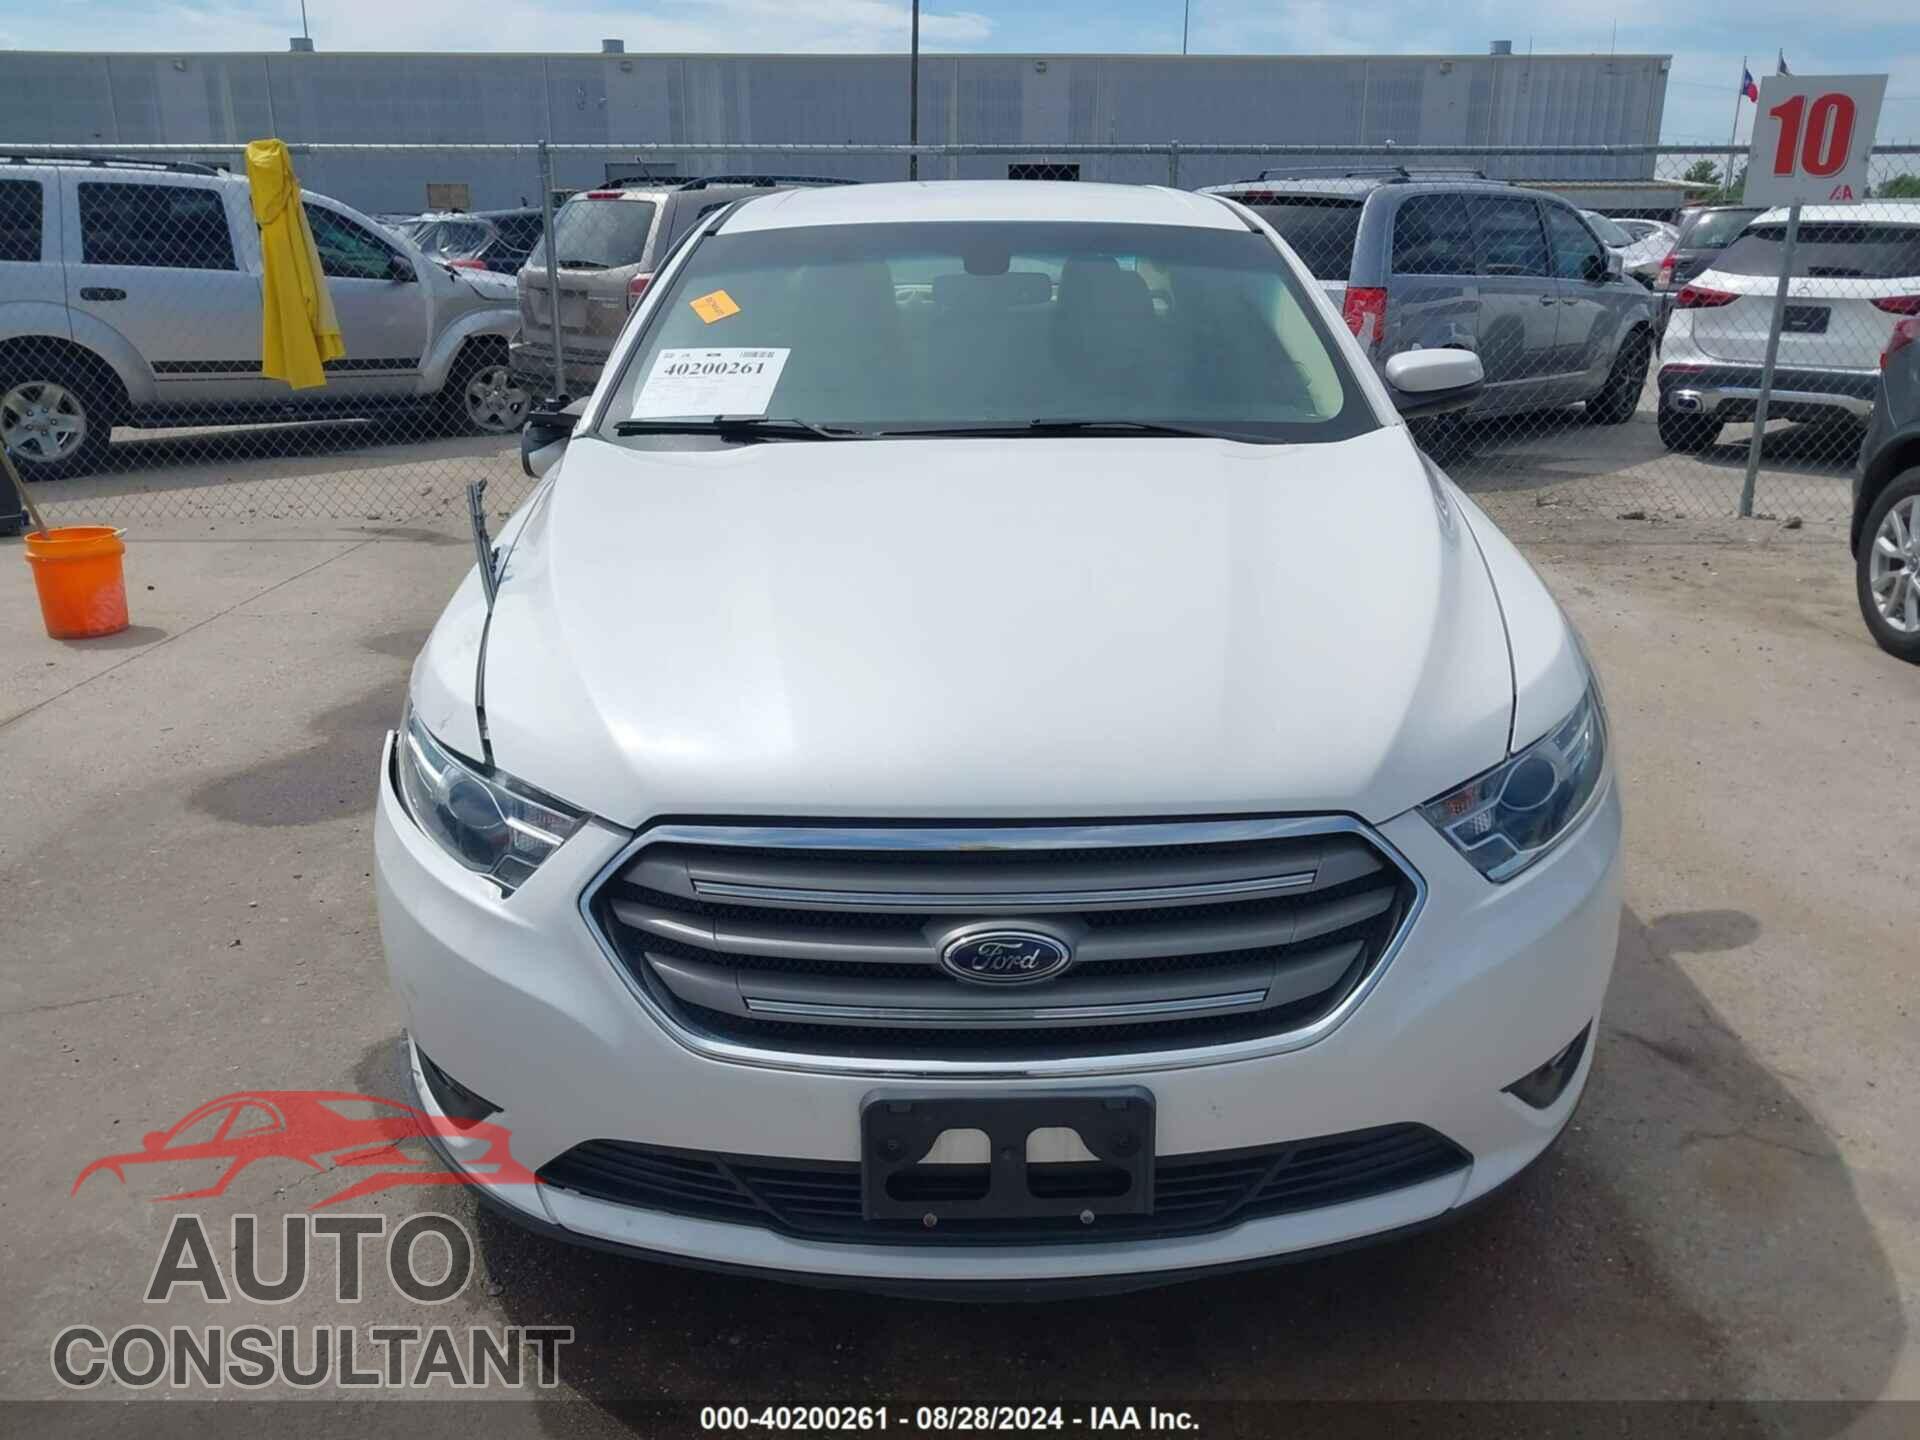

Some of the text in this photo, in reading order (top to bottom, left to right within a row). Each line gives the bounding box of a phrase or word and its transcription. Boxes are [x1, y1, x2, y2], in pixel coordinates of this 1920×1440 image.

[1770, 92, 1857, 177] 10
[664, 361, 765, 375] 40200261
[972, 942, 1041, 970] Ford
